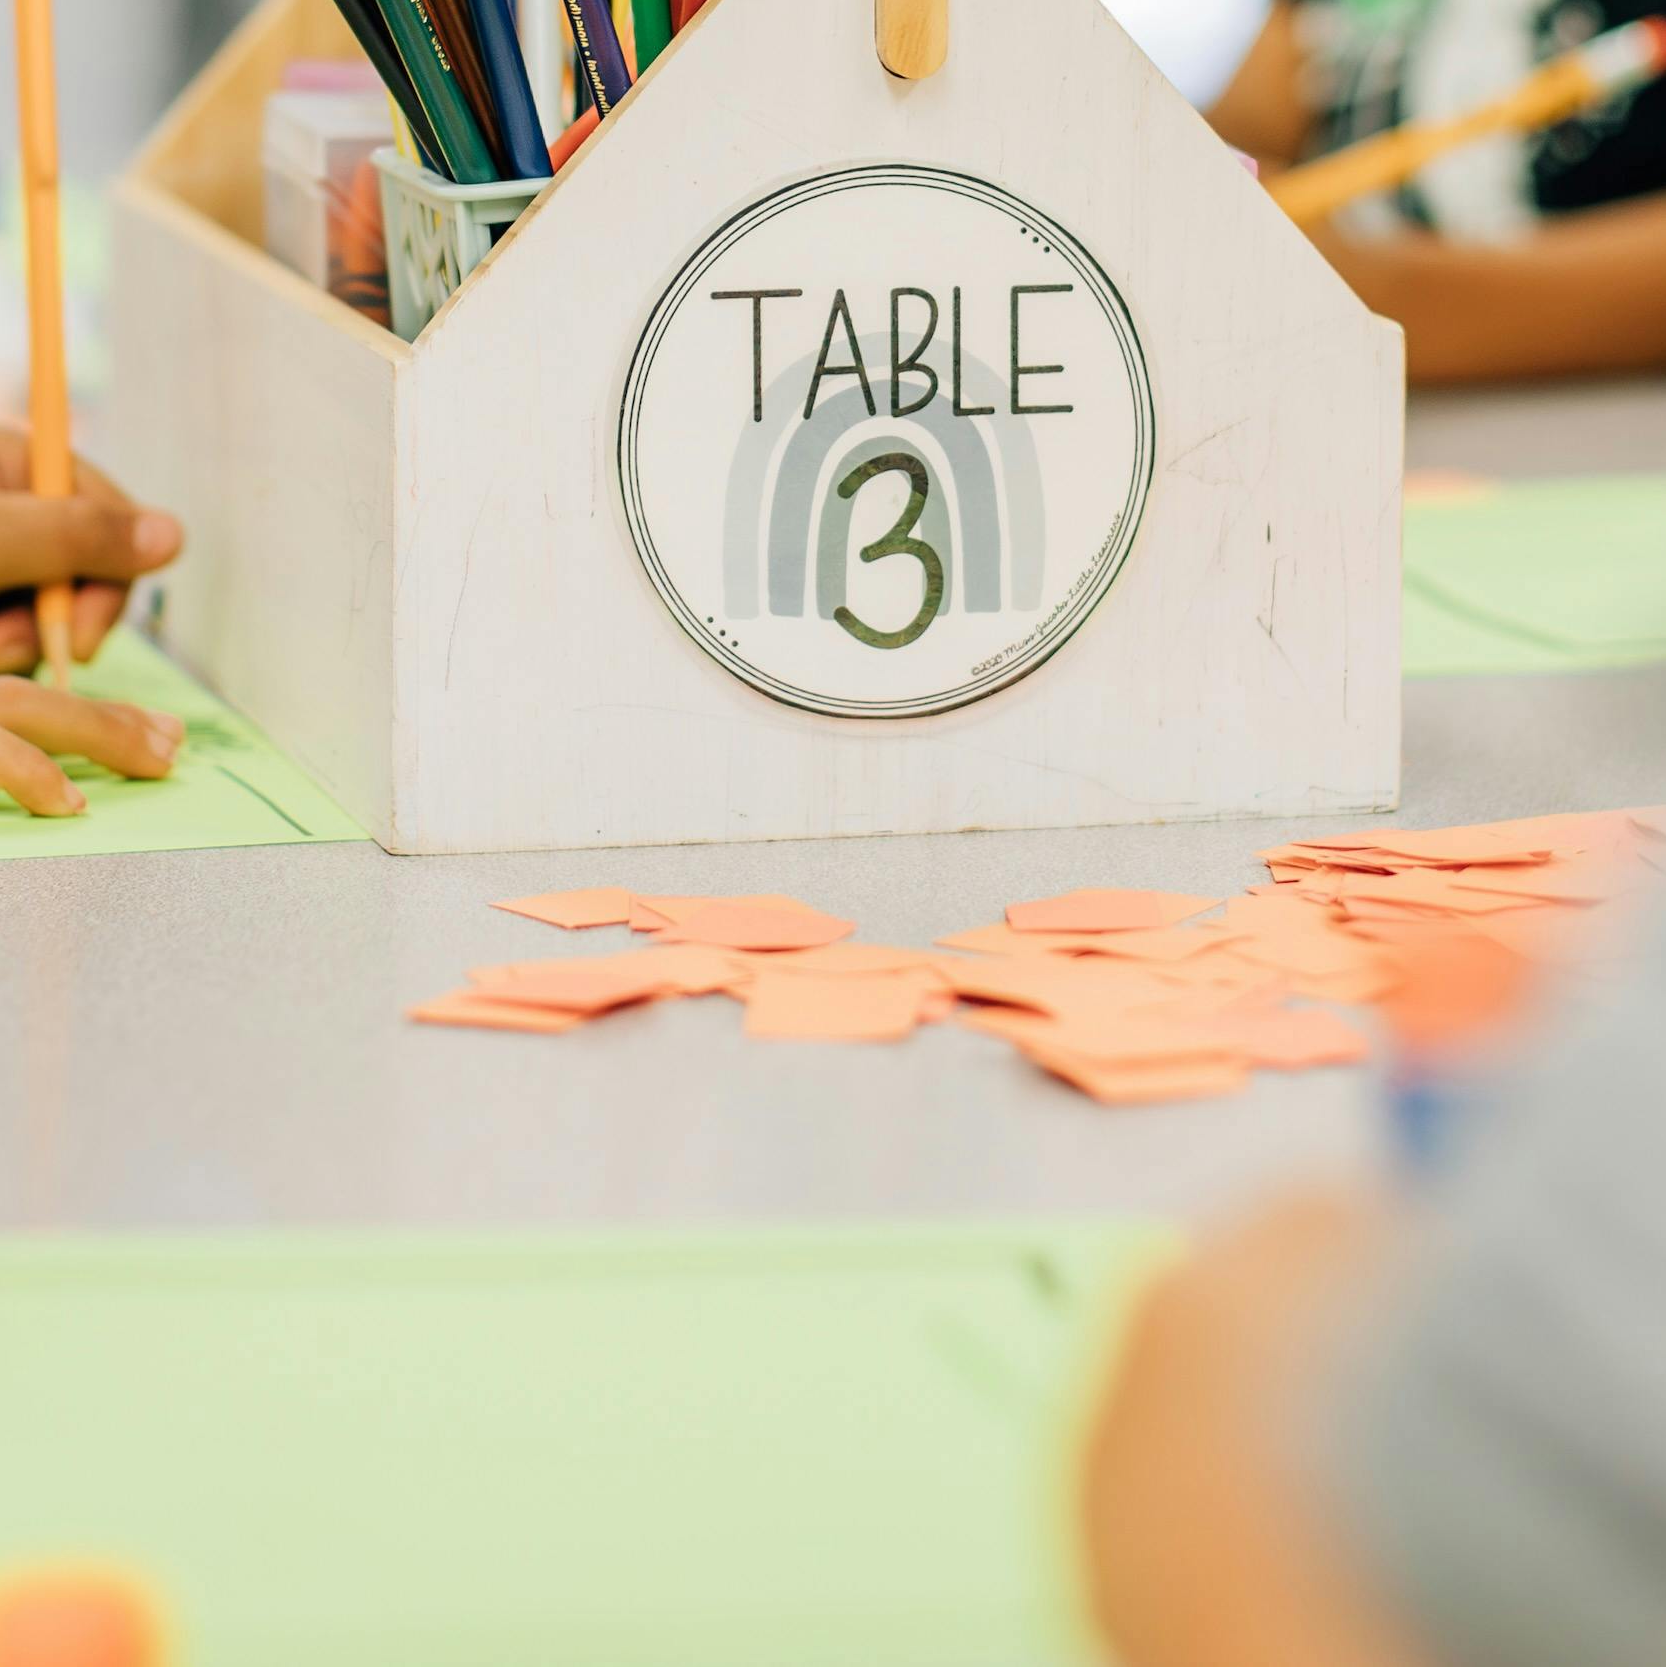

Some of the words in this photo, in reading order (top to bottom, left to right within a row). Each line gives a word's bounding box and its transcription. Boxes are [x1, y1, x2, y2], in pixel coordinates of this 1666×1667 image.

[711, 284, 1074, 422] TABLE
[833, 451, 944, 649] 3
[1005, 634, 1035, 659] Miss
[1035, 599, 1069, 635] Jacobs
[1068, 566, 1094, 599] Little
[1091, 511, 1122, 567] Learners
